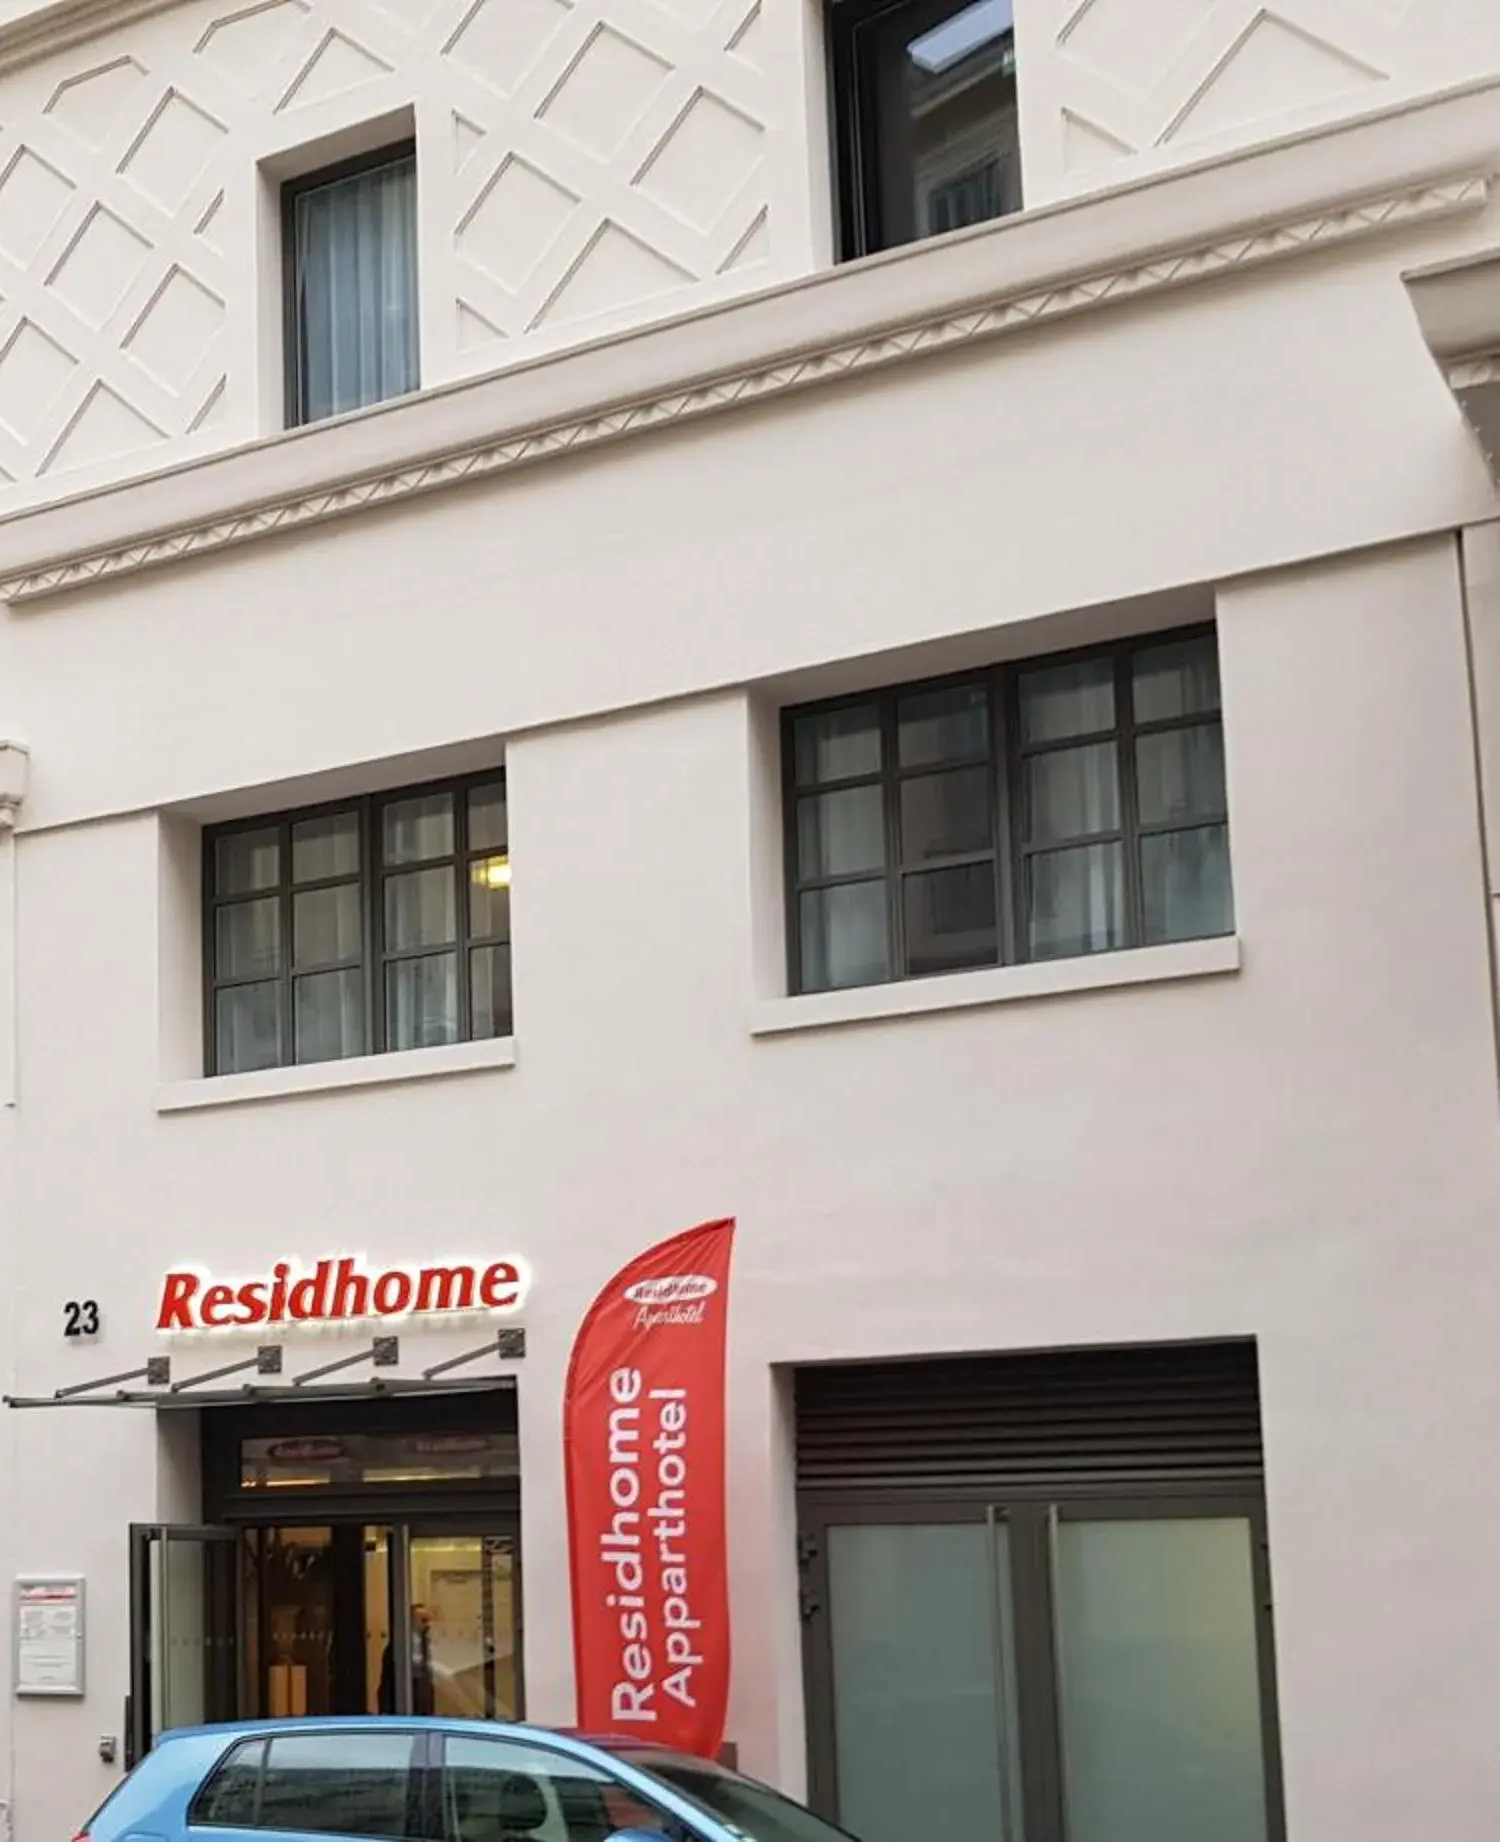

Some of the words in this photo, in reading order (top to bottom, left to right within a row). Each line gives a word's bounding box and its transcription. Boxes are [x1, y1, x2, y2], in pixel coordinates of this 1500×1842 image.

[63, 1300, 100, 1337] 23
[156, 1257, 520, 1329] Residhome
[600, 1366, 657, 1722] Residhome
[647, 1387, 704, 1707] Apparthotel
